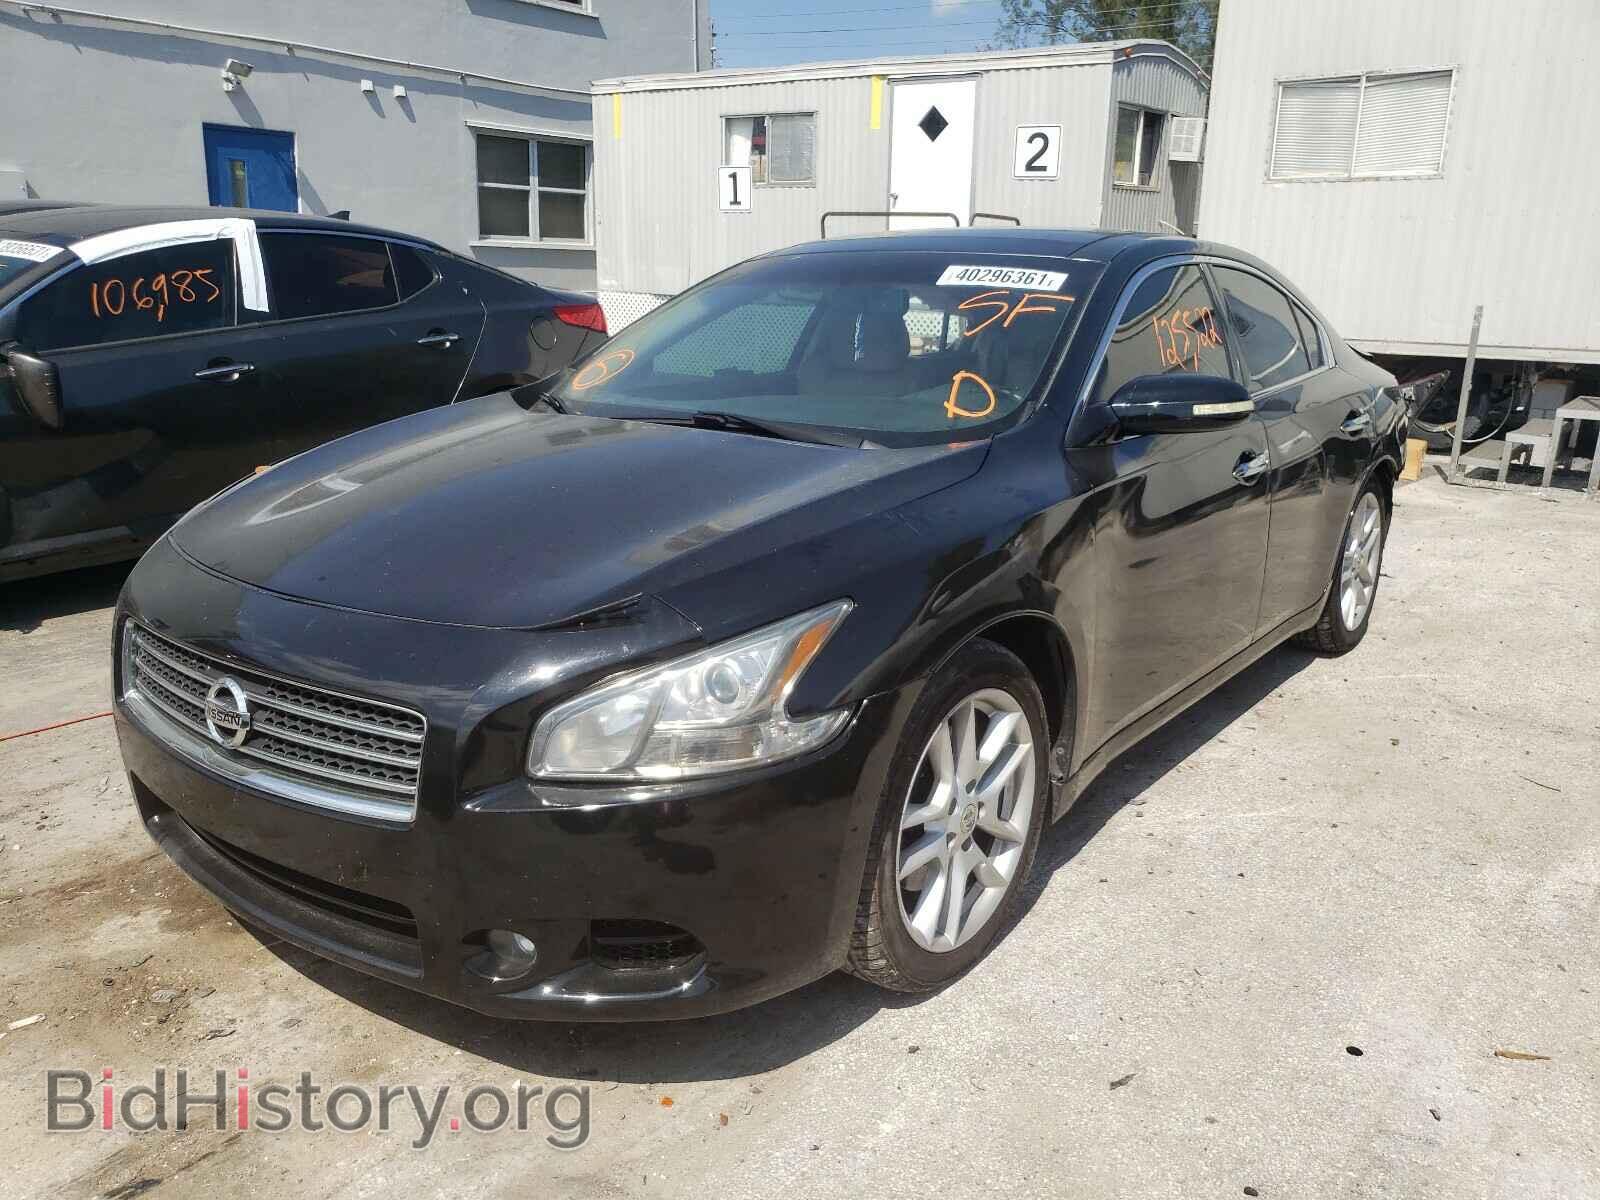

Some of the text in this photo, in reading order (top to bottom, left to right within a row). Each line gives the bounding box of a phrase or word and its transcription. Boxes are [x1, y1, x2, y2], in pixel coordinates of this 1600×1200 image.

[1024, 132, 1050, 173] 2
[727, 172, 742, 206] 1
[90, 268, 220, 322] 106,985
[955, 267, 1048, 285] 40296361
[957, 290, 1076, 337] SF
[943, 370, 996, 418] D
